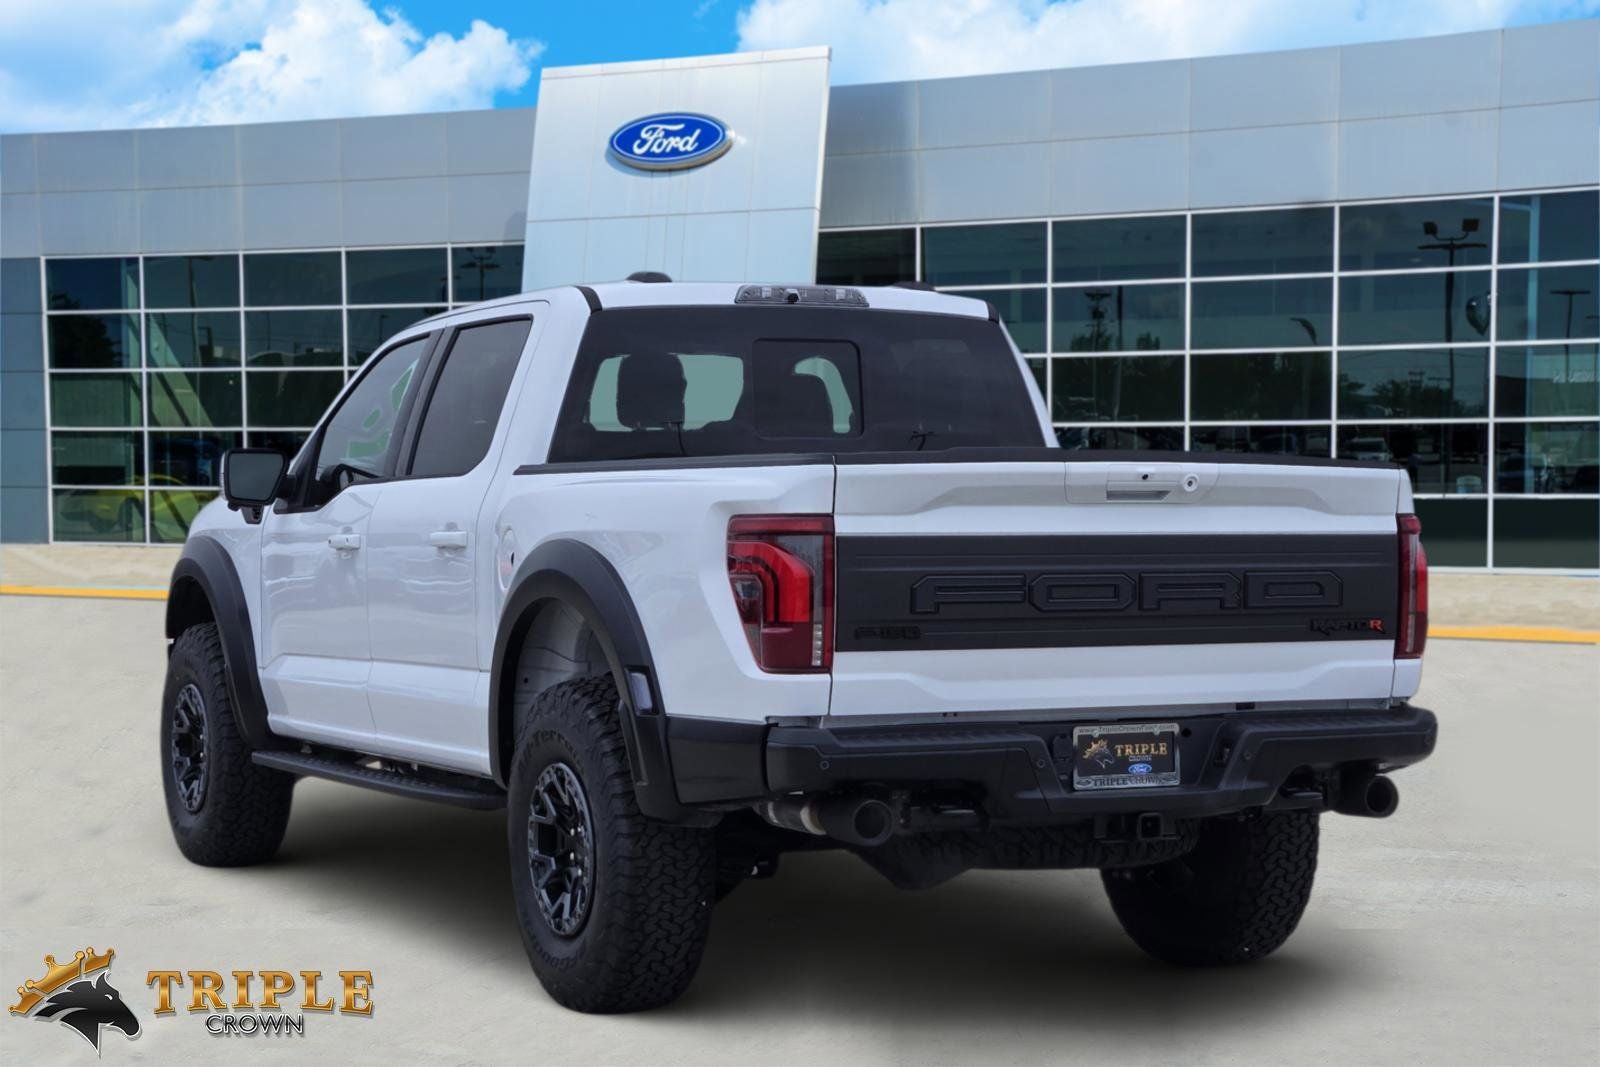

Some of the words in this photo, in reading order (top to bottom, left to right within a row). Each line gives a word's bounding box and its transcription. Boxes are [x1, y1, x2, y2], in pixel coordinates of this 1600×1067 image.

[632, 123, 701, 155] Ford
[911, 571, 1343, 614] FORD
[1309, 617, 1385, 636] RAPTOR
[1114, 743, 1168, 757] TRIPLE
